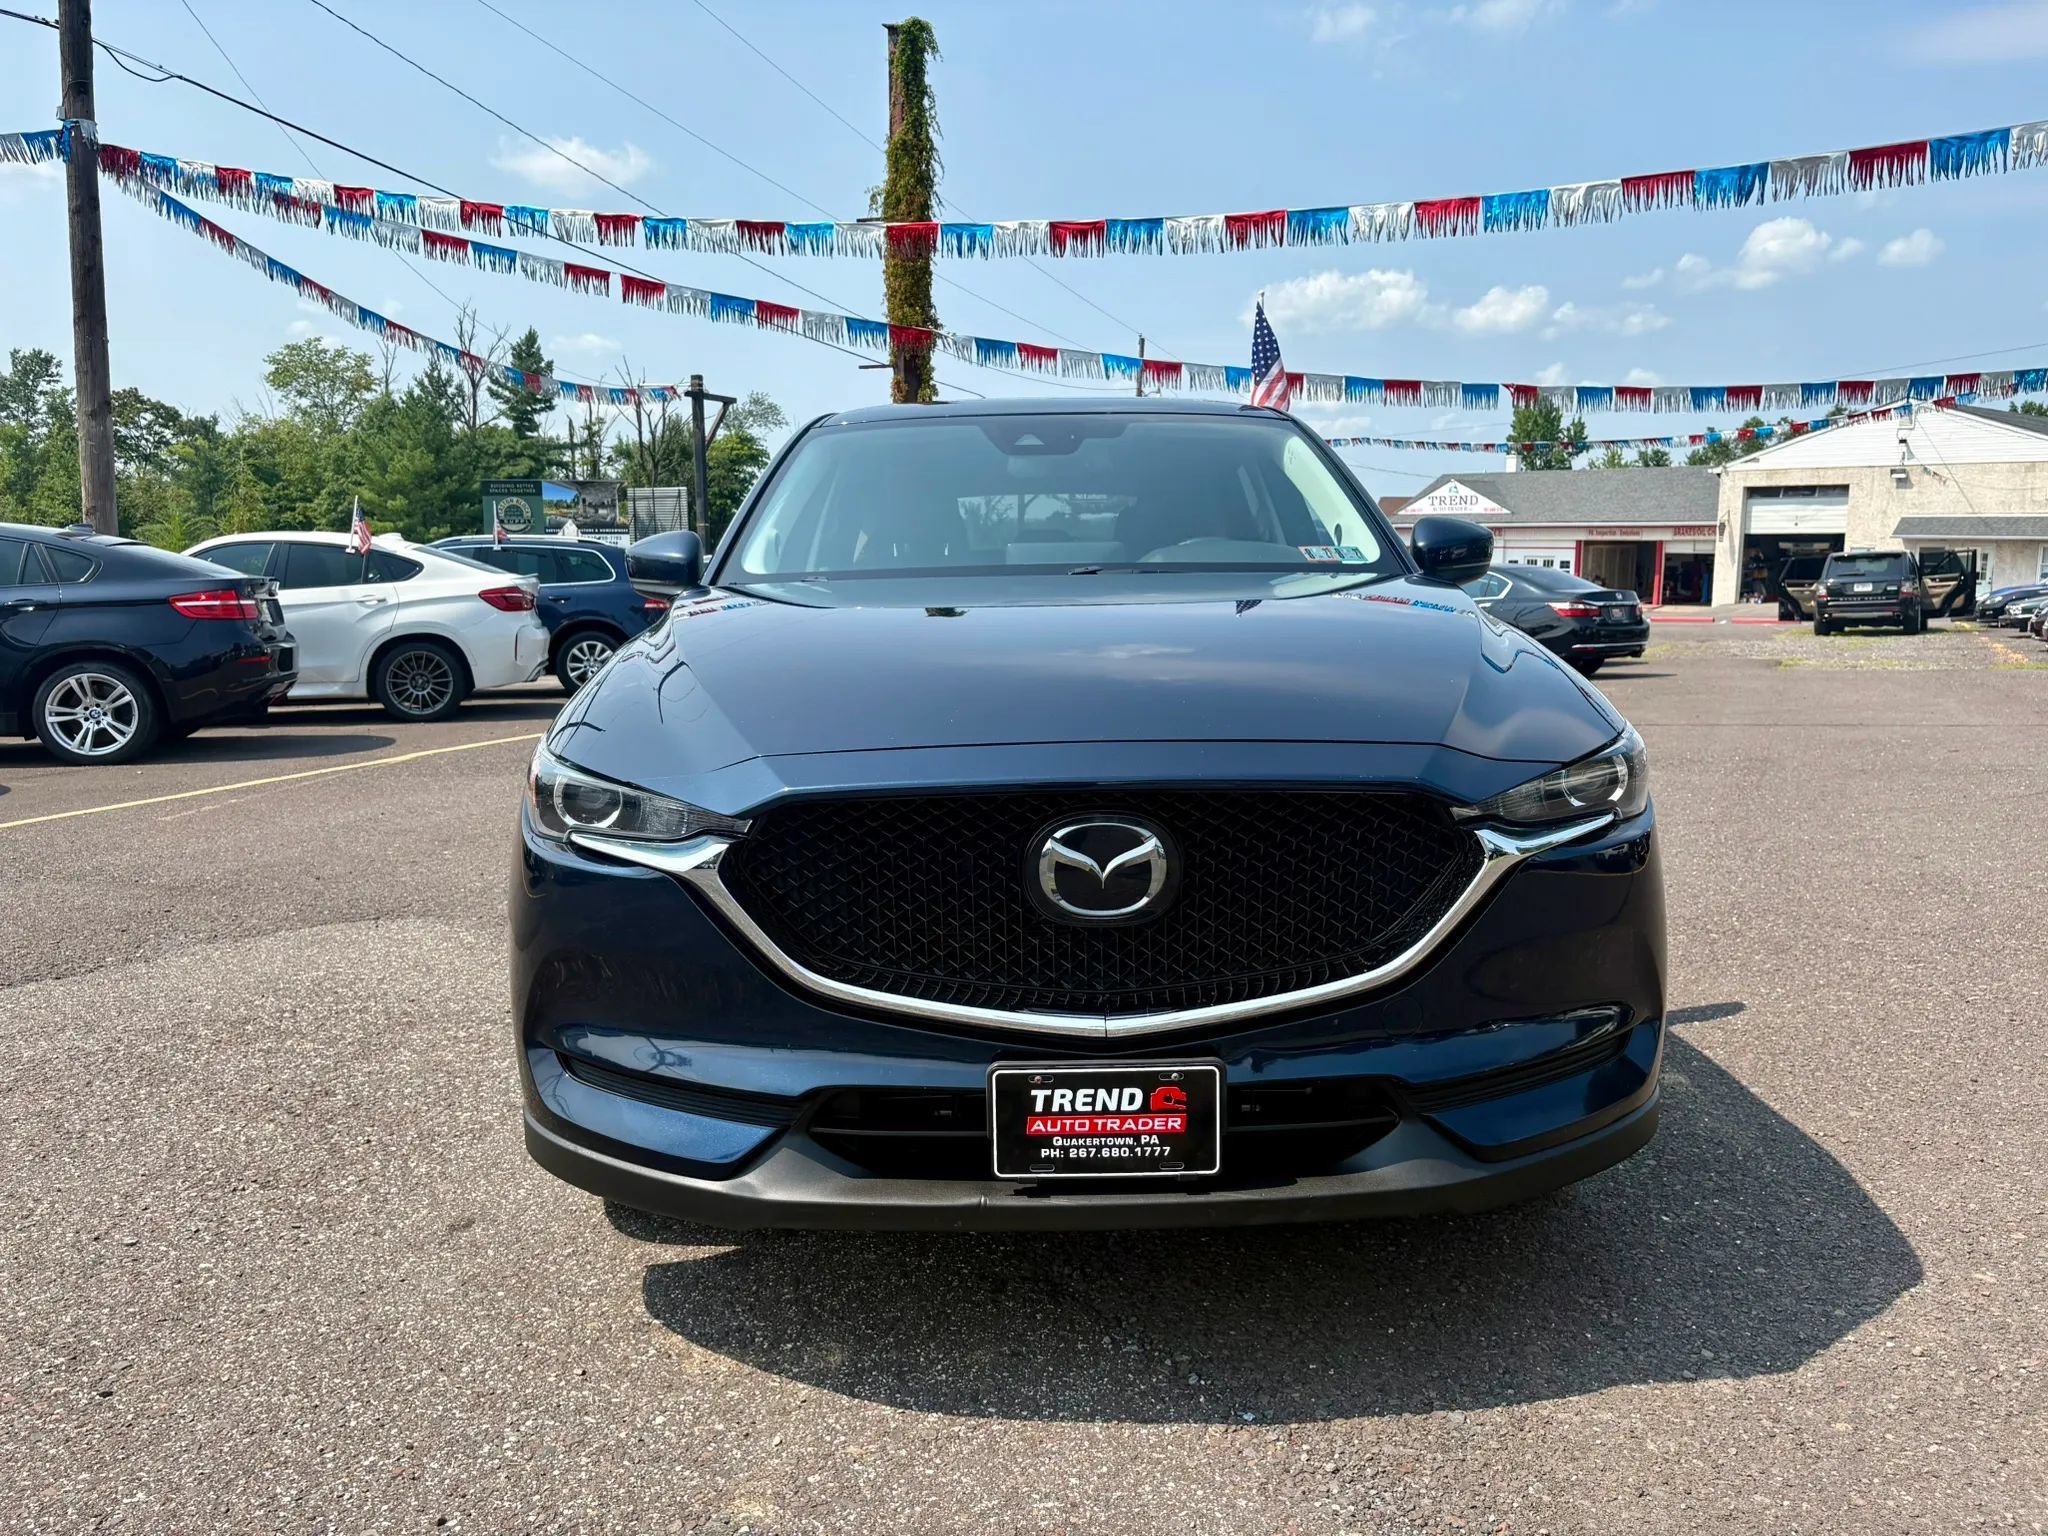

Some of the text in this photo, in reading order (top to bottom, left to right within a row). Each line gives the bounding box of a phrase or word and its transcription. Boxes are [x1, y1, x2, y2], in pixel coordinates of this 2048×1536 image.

[1428, 495, 1479, 507] TREND
[1031, 1088, 1143, 1112] TREND
[1031, 1118, 1182, 1132] AUTO TRADER
[1141, 1135, 1159, 1145] PA
[1041, 1147, 1171, 1158] PH: 267.680.1777
